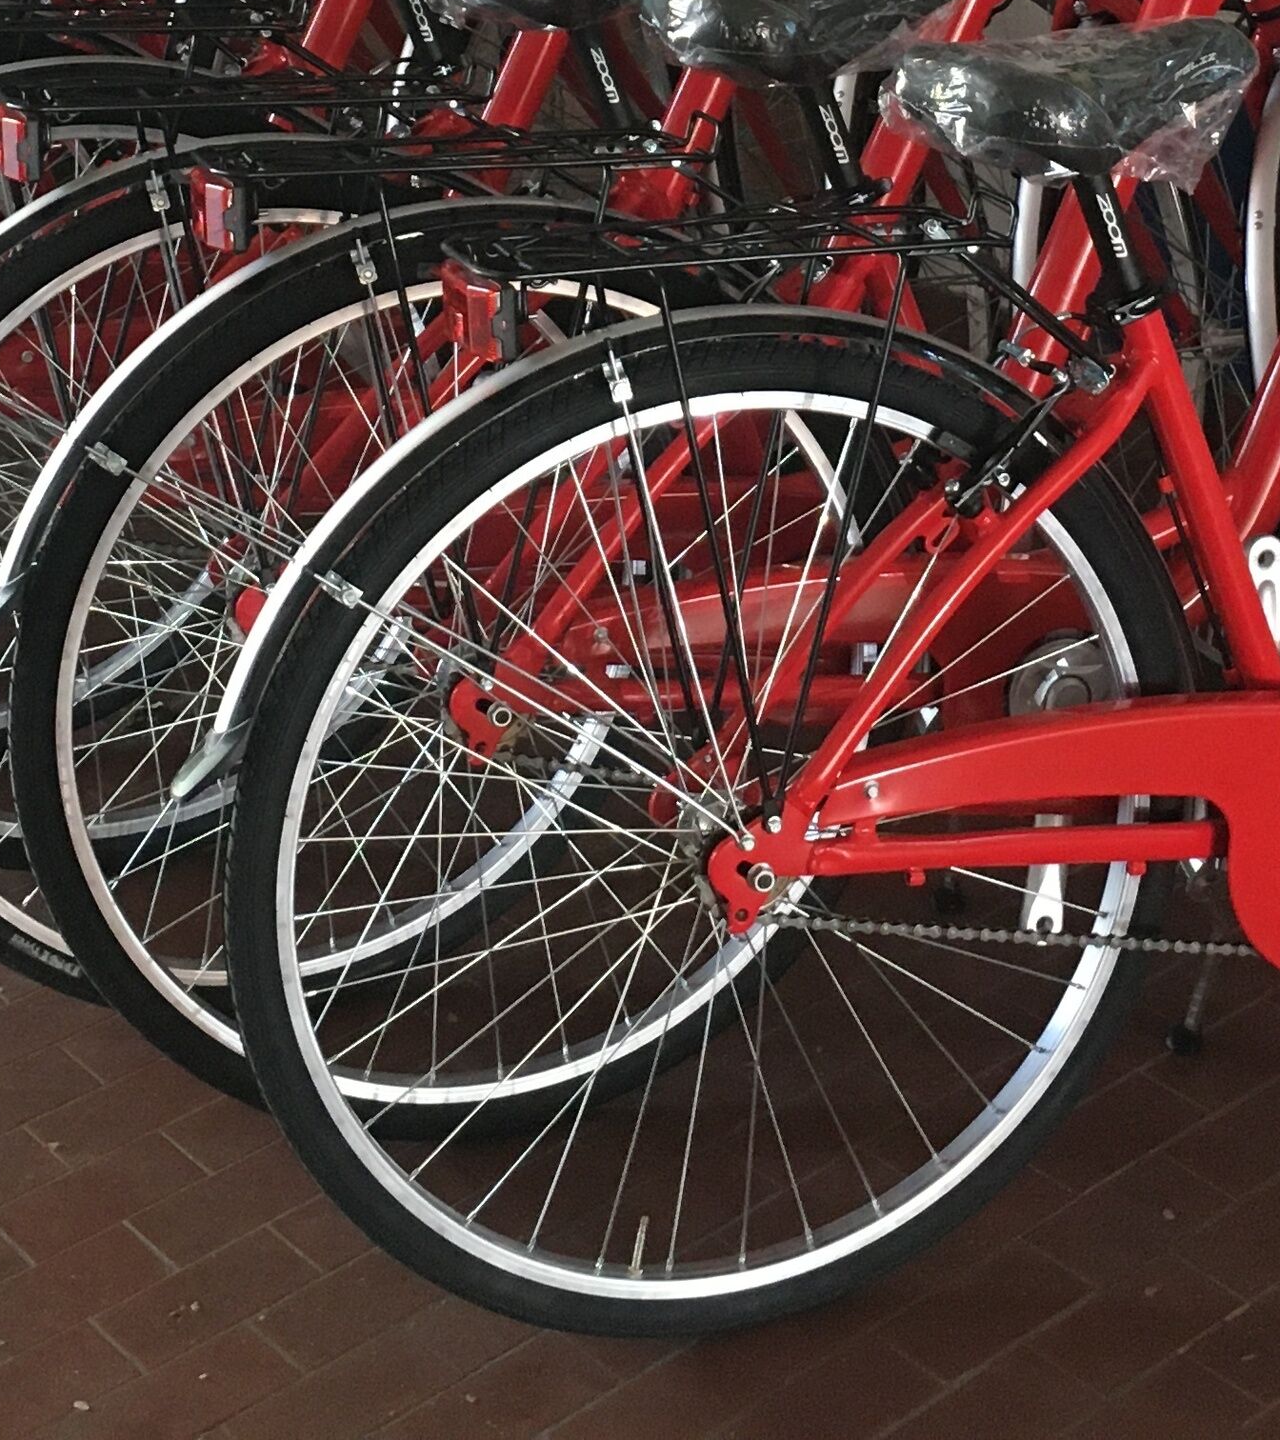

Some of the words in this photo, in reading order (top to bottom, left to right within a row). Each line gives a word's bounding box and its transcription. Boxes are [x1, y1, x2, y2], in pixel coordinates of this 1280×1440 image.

[590, 47, 620, 104] ZOOM
[818, 104, 850, 164] ZOOM
[1095, 193, 1128, 258] ZOOM
